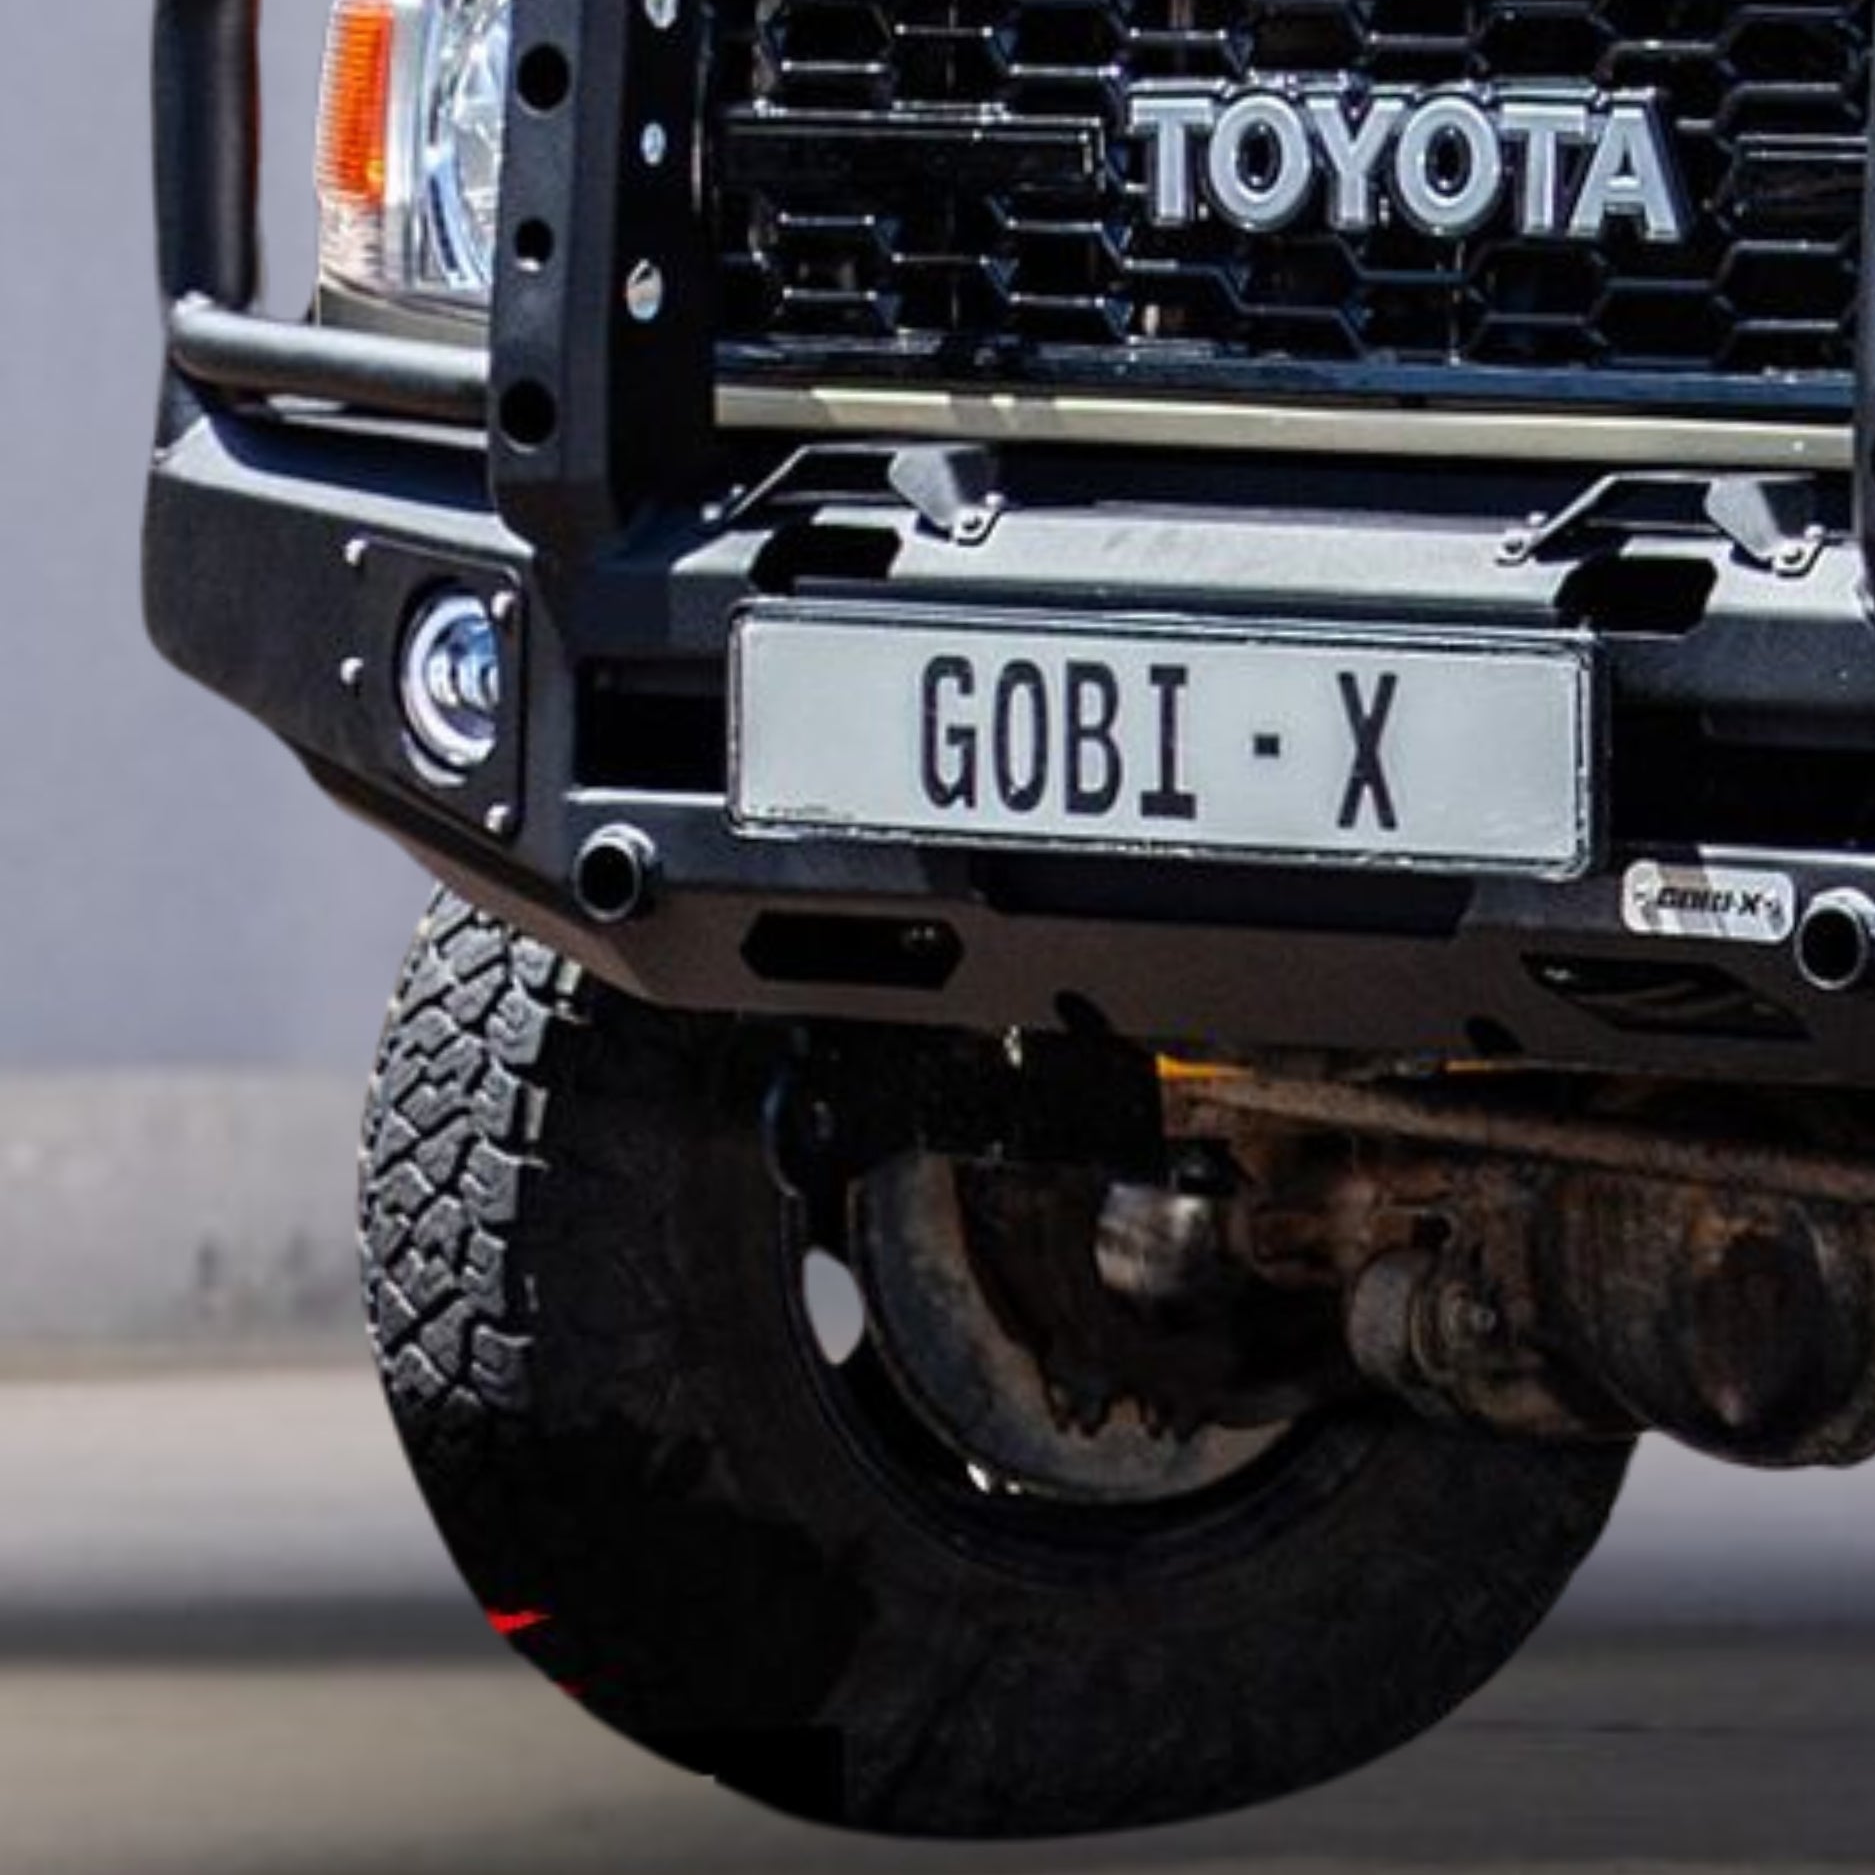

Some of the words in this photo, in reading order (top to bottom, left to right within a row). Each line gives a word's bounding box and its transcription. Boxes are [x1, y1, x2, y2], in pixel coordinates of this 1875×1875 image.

[1127, 73, 1681, 242] TOYOTA
[921, 654, 1197, 820] GOBI
[1336, 671, 1398, 830] X
